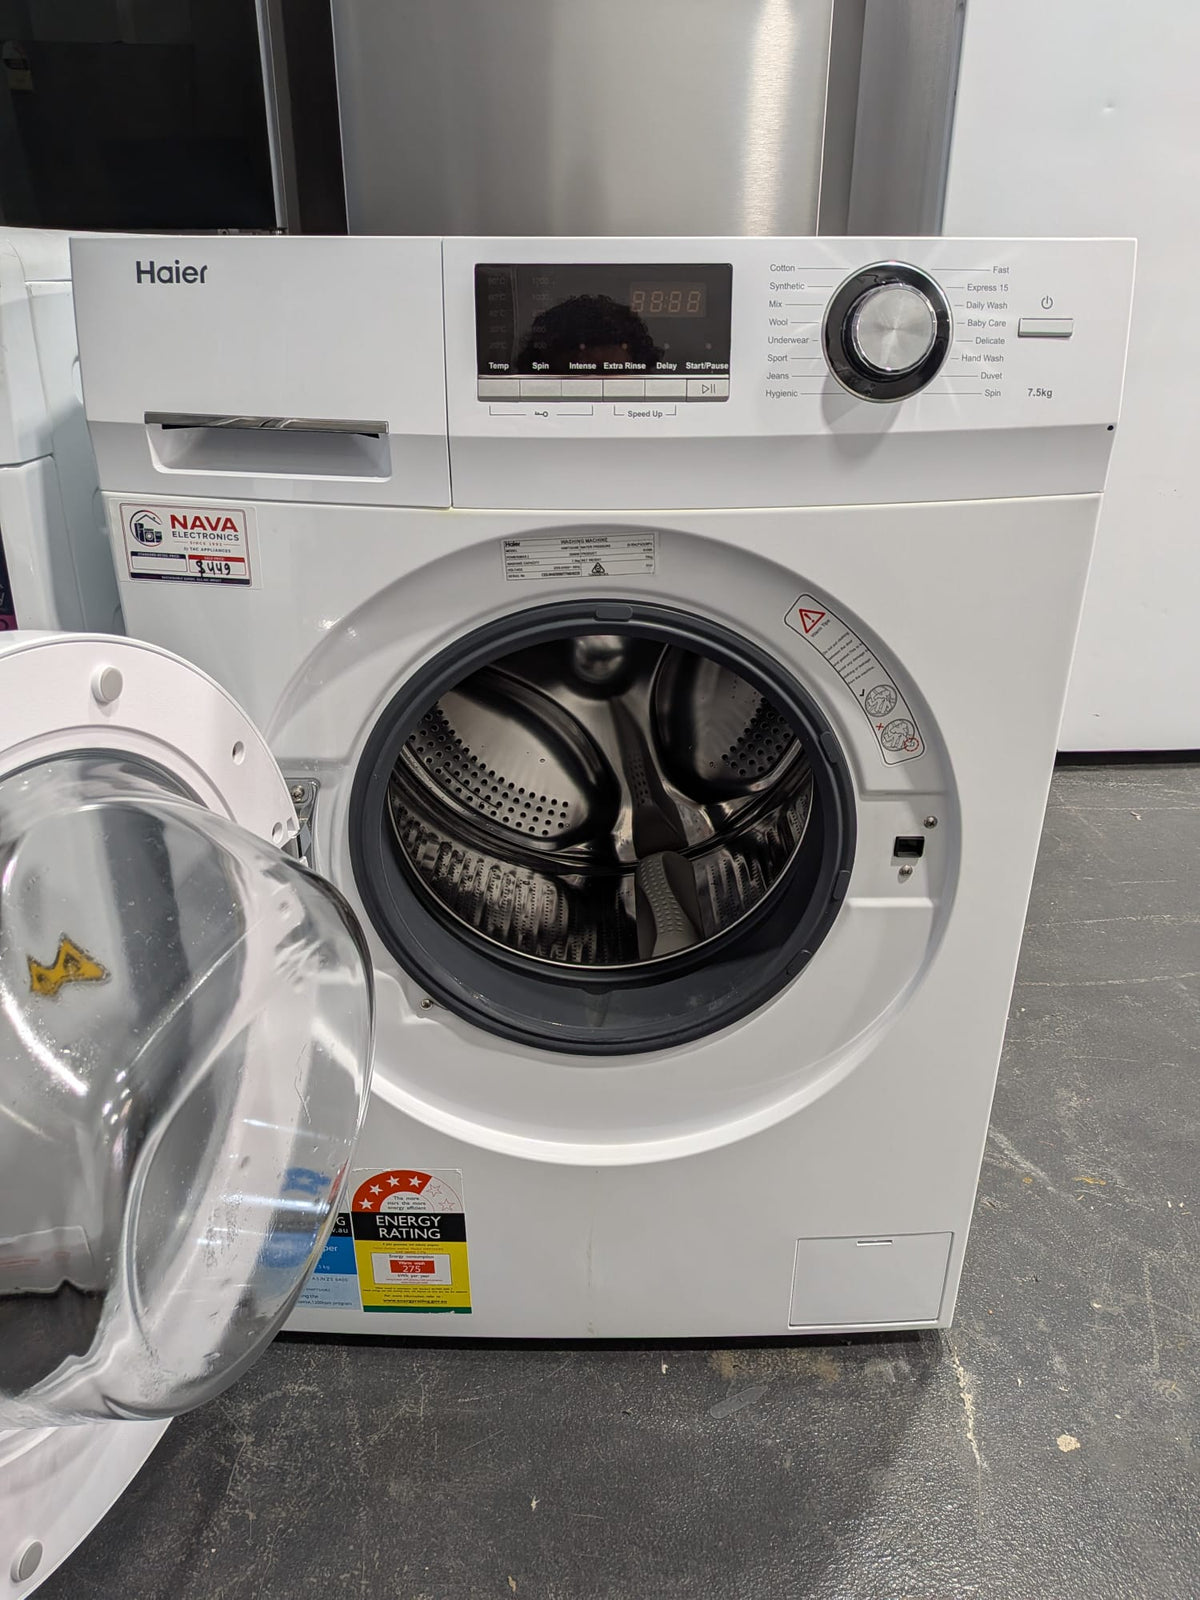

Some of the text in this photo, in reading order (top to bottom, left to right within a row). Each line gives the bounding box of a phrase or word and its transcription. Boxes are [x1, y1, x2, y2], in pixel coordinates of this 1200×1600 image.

[136, 259, 208, 284] Haier
[770, 264, 796, 272] Cotton
[993, 266, 1010, 274] Fast
[769, 282, 805, 292] Synthetic
[967, 284, 1009, 294] Express 15
[768, 300, 782, 308] Mix
[966, 301, 1008, 311] Daily Wash
[768, 318, 788, 326] Wool
[967, 319, 1006, 329] Baby Care
[768, 336, 809, 344] Underwear
[975, 336, 1006, 345] Delicate
[768, 354, 788, 364] Sport
[961, 354, 1004, 362] Hand Wash
[488, 362, 510, 372] Temp
[532, 362, 550, 371] Spin
[656, 362, 677, 371] Delay
[766, 372, 790, 380] Jeans
[980, 372, 1002, 380] Duvet
[765, 389, 798, 399] Hygienic
[984, 389, 1002, 399] Spin
[1027, 388, 1053, 399] 7.5kg
[628, 411, 663, 419] Speed Up
[170, 514, 238, 532] NAVA
[172, 531, 240, 542] ELECTRONICS
[196, 560, 230, 577] $449
[376, 1216, 441, 1226] ENERGY
[379, 1228, 440, 1239] RATING
